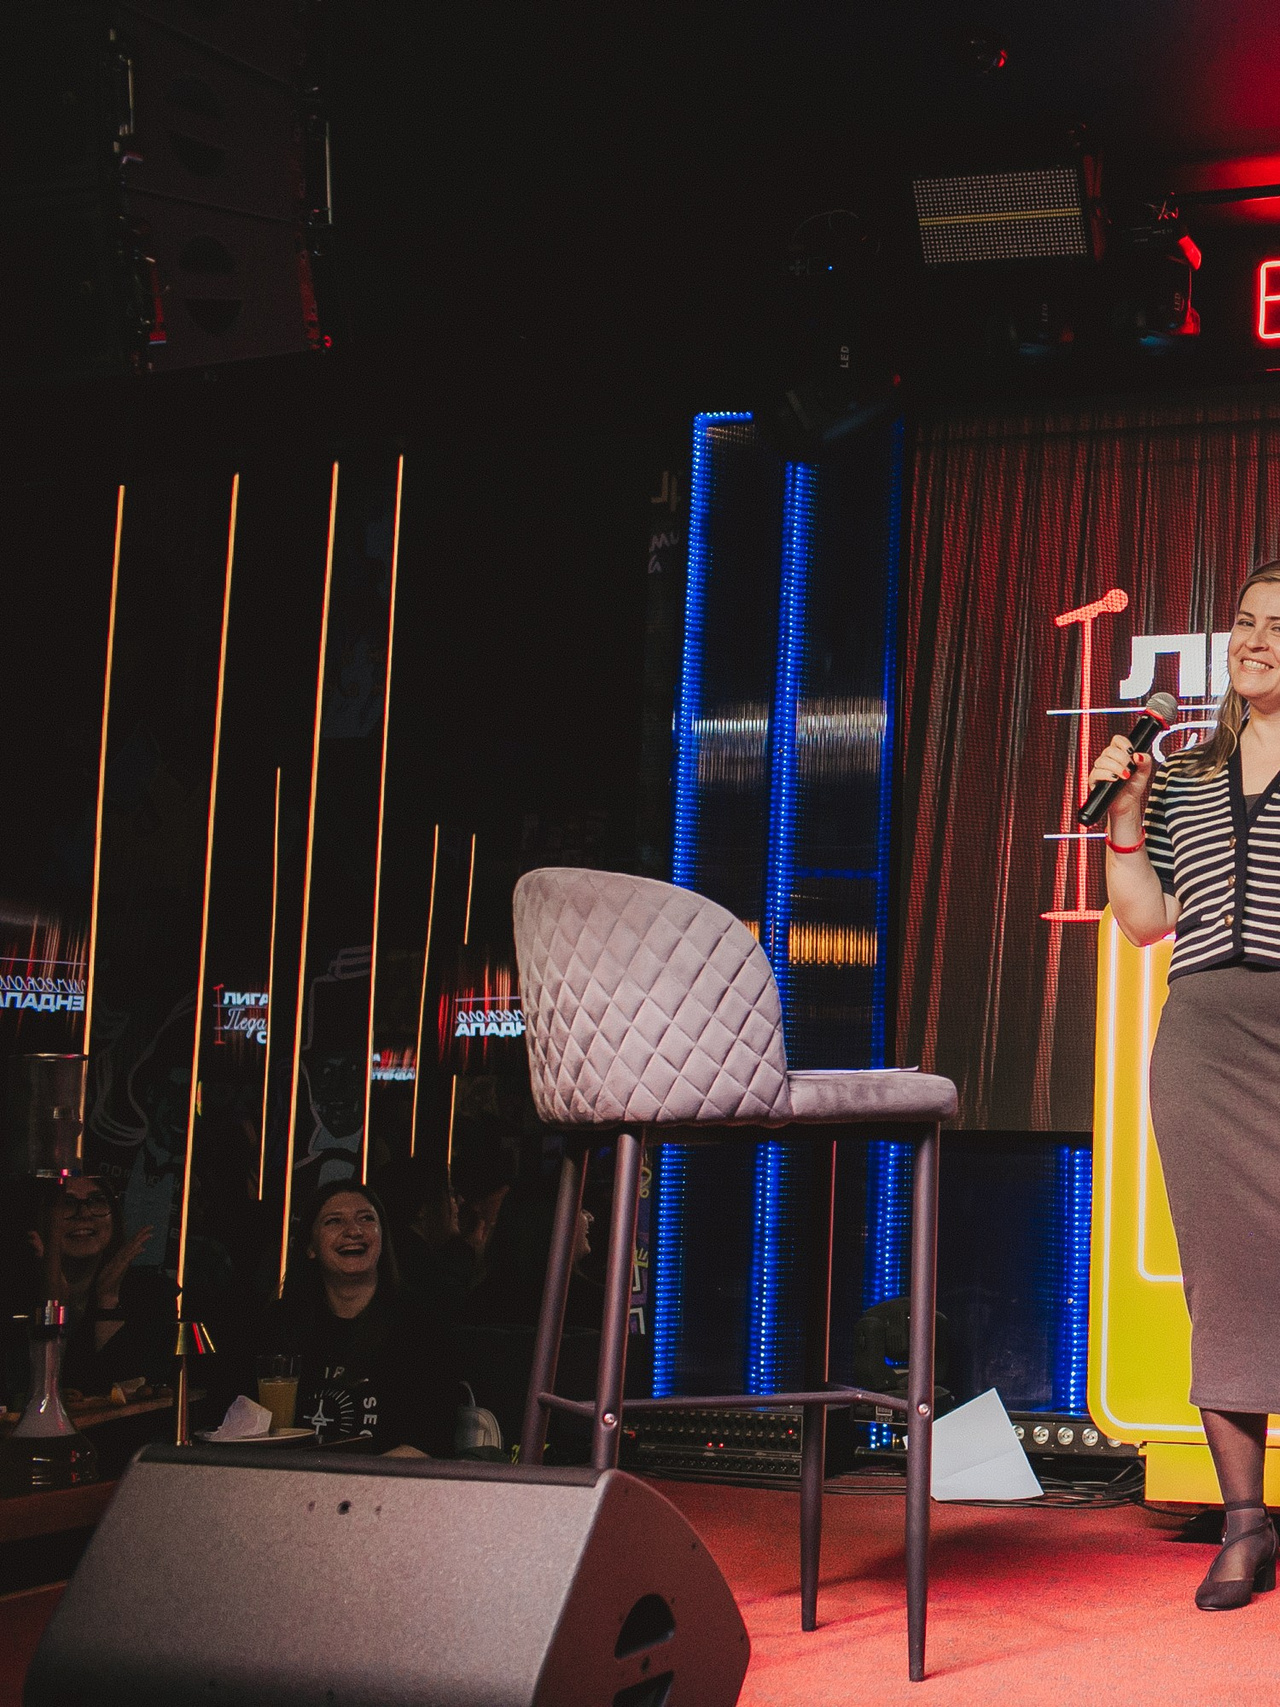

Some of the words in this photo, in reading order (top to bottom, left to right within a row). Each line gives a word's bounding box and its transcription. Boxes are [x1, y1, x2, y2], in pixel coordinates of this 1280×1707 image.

[840, 346, 849, 368] LED
[223, 991, 268, 1006] ЛИГА
[224, 1007, 267, 1040] Педа
